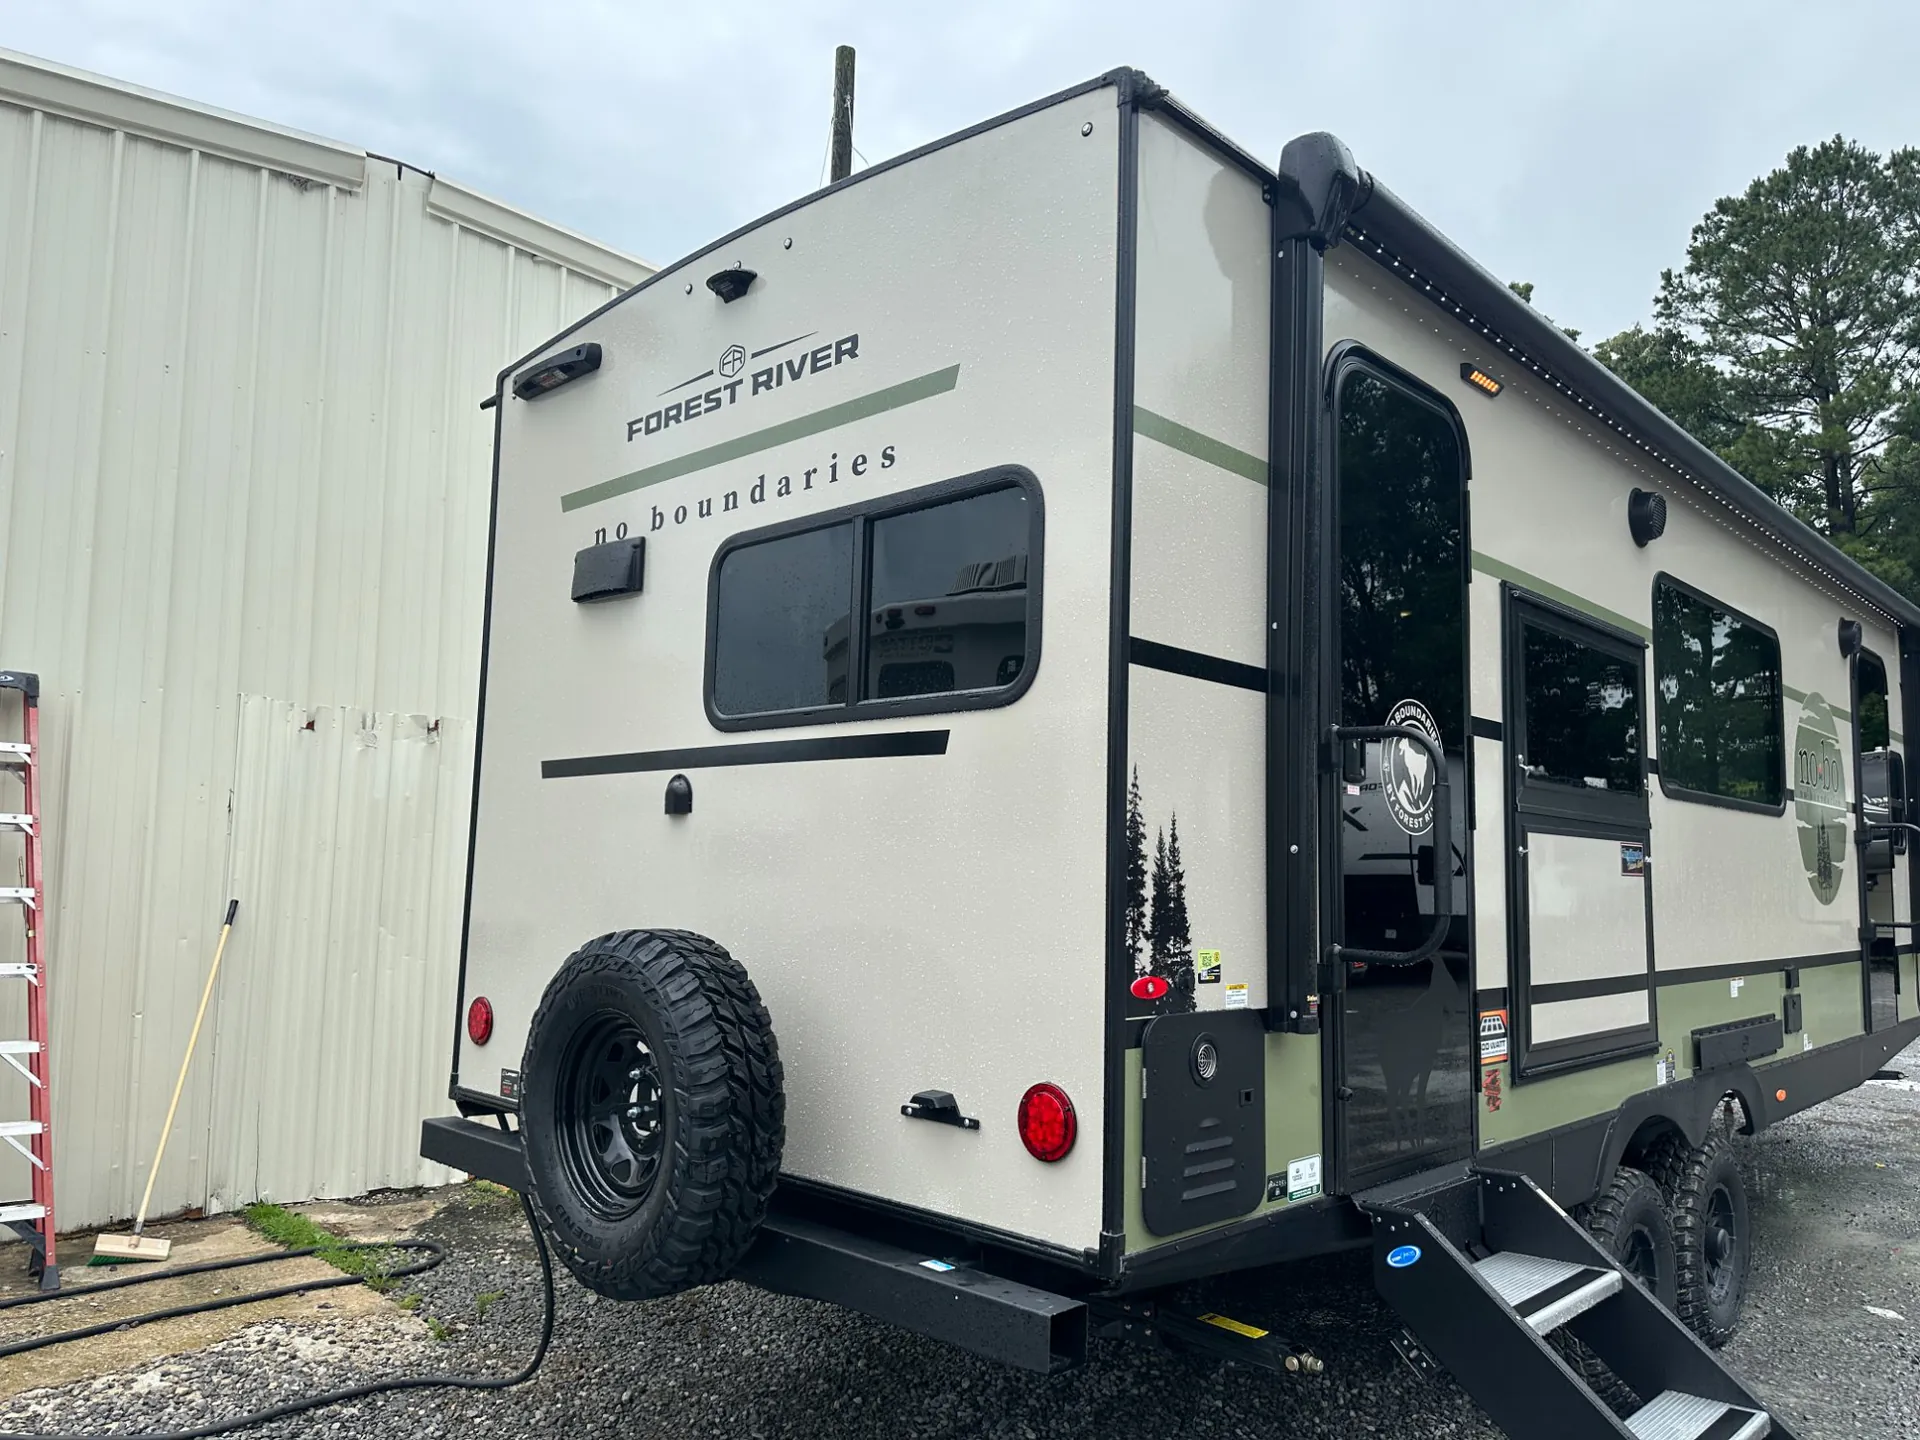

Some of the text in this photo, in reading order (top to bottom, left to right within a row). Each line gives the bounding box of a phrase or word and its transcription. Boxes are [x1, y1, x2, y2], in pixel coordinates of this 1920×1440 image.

[626, 333, 860, 443] FOREST RIVER
[594, 444, 897, 546] no boundaries
[1386, 784, 1423, 828] BY FOREST
